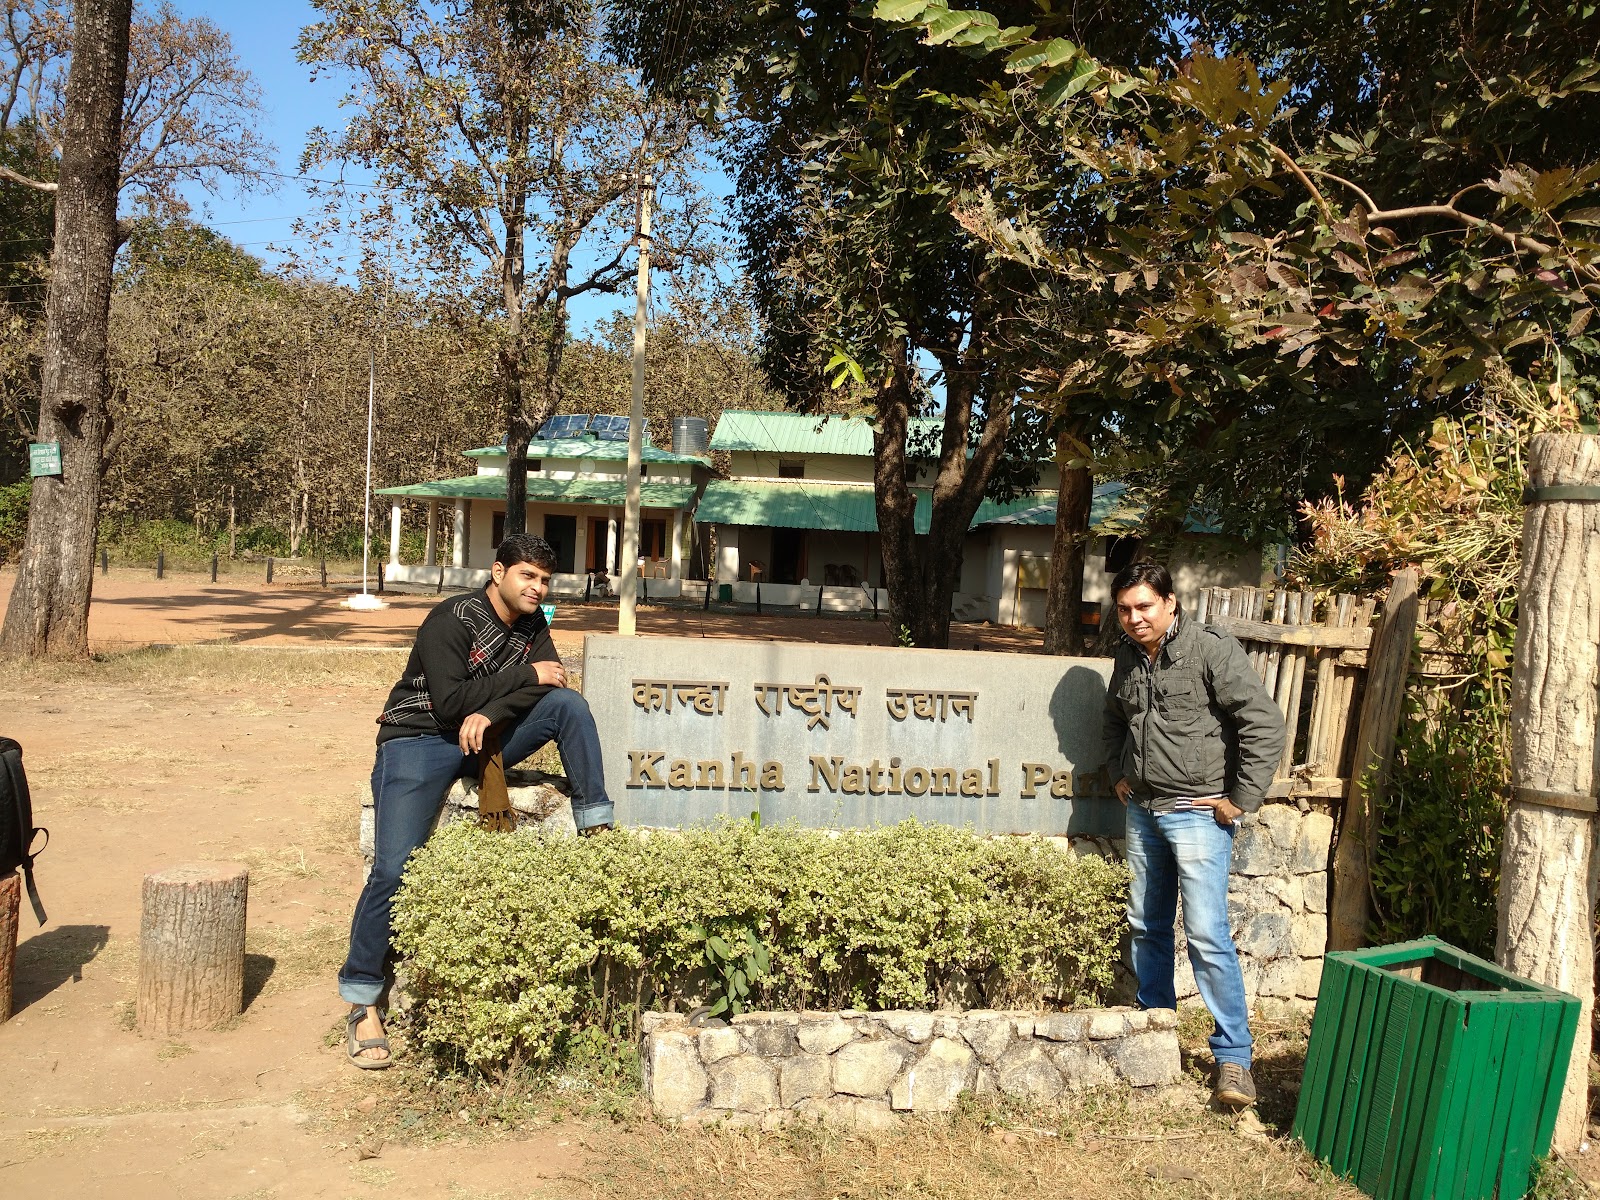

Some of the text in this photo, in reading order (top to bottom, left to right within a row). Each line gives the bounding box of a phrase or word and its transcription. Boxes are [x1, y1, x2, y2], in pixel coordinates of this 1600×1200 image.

[632, 673, 979, 731] कान्हा राष्ट्रीय उद्यान
[626, 751, 785, 792] Kanha
[807, 756, 1001, 798] National
